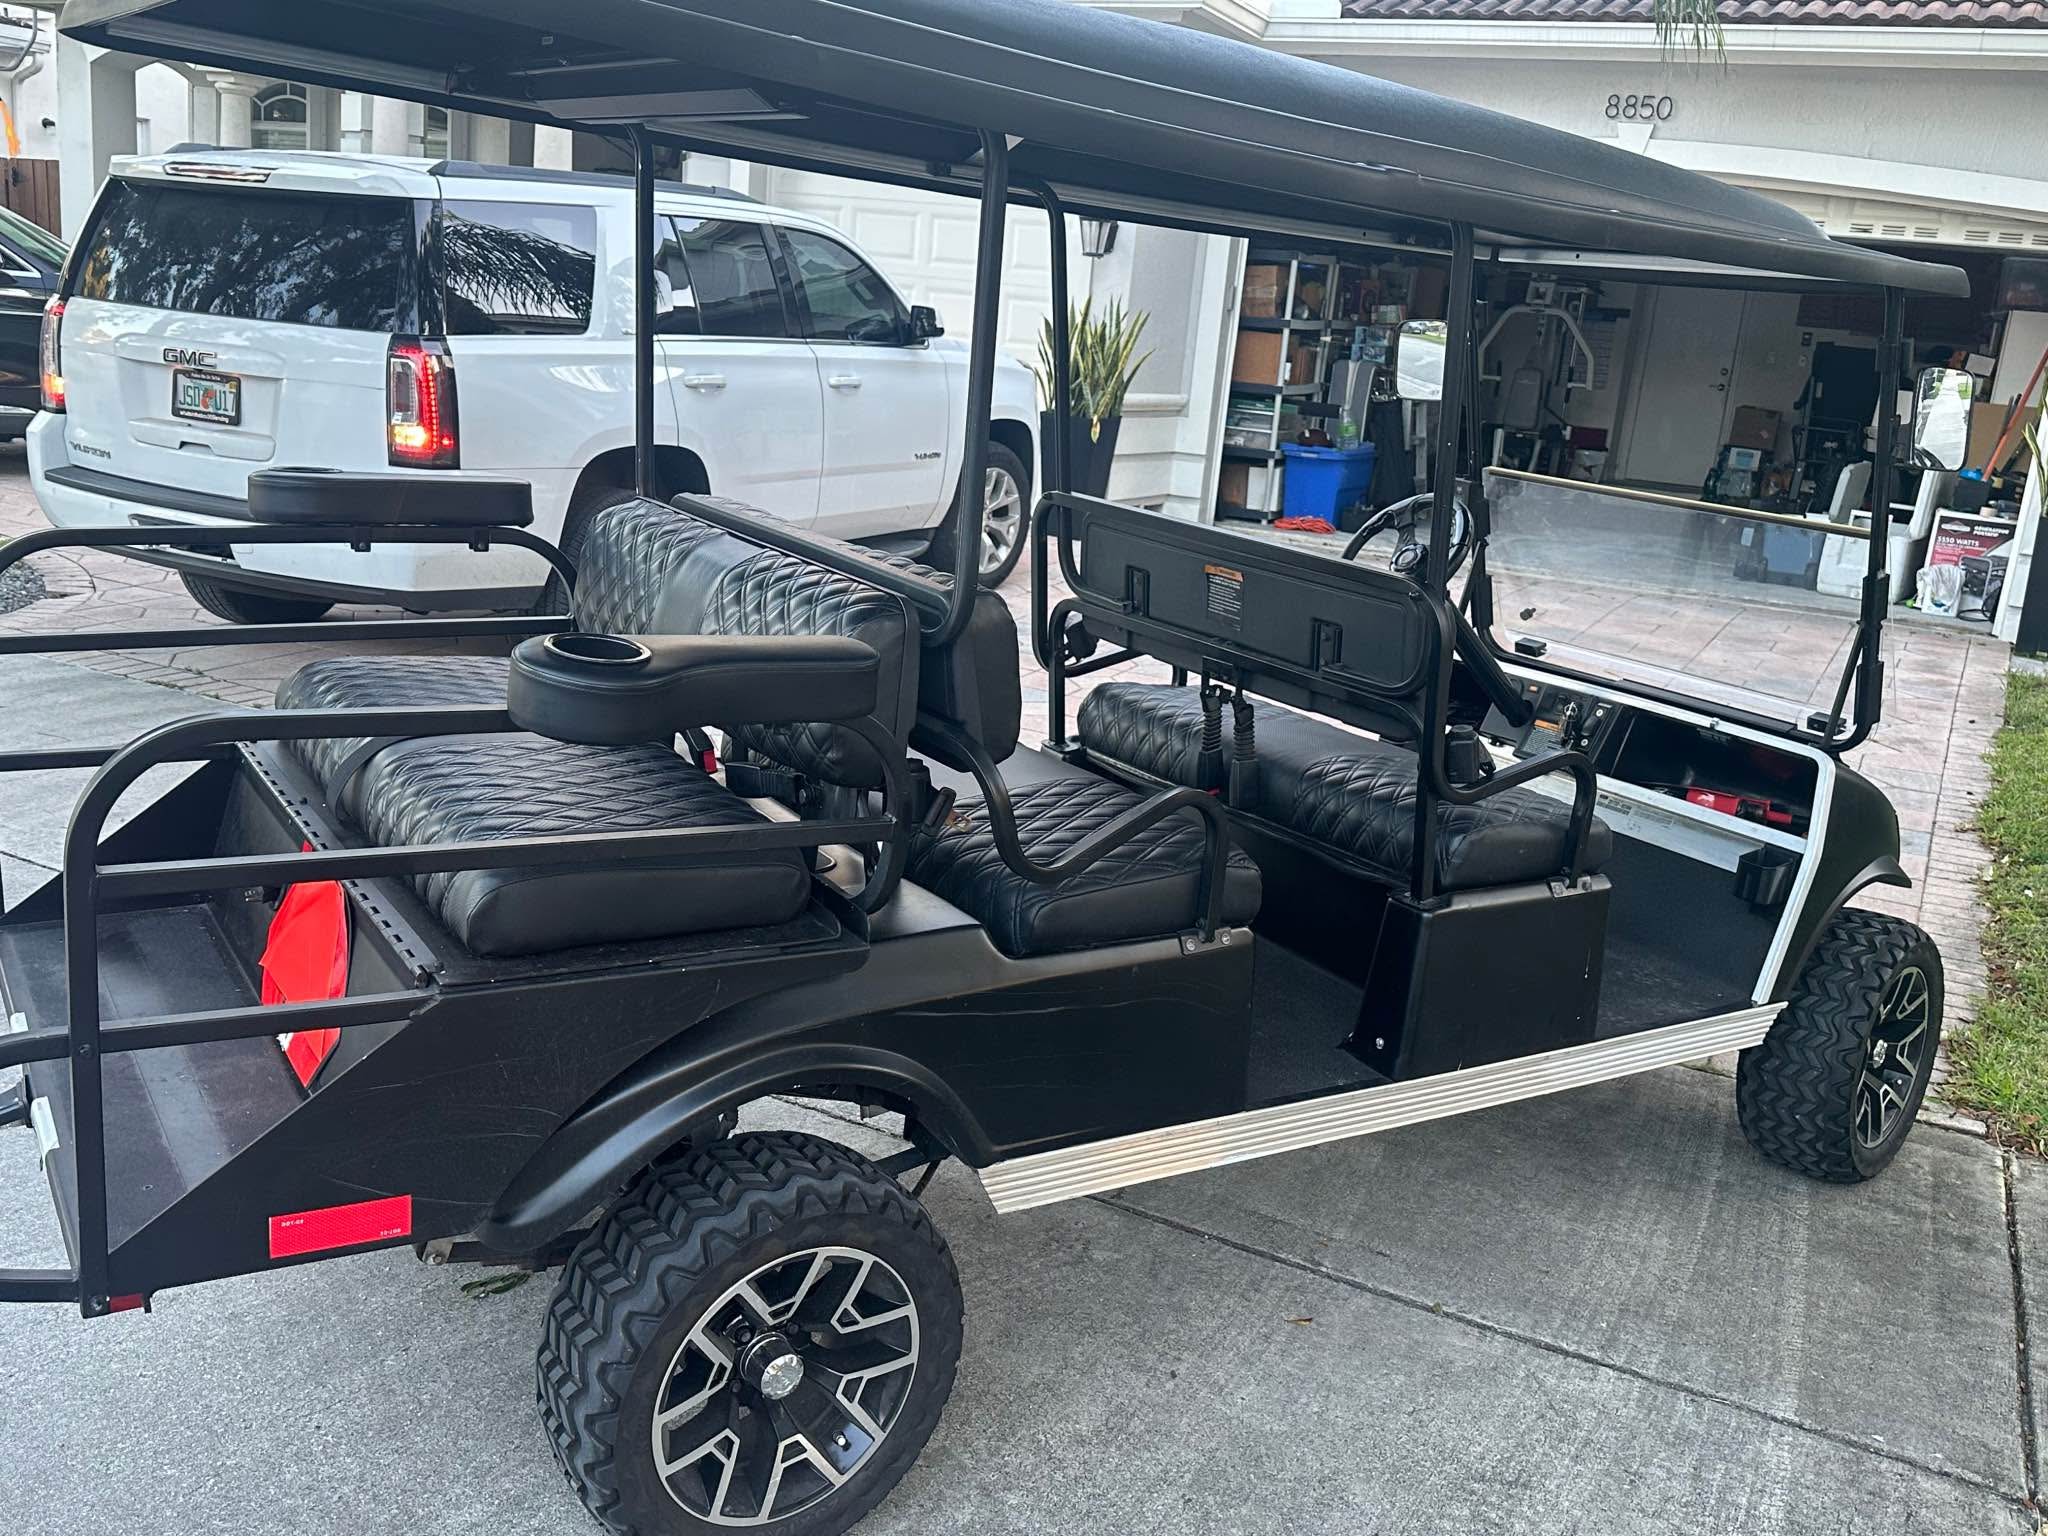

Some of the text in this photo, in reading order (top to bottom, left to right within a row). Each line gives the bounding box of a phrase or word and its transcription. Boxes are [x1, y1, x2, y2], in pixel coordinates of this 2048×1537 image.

[1605, 94, 1673, 120] 8850
[163, 347, 217, 369] GMC
[1956, 538, 1980, 547] WATTS
